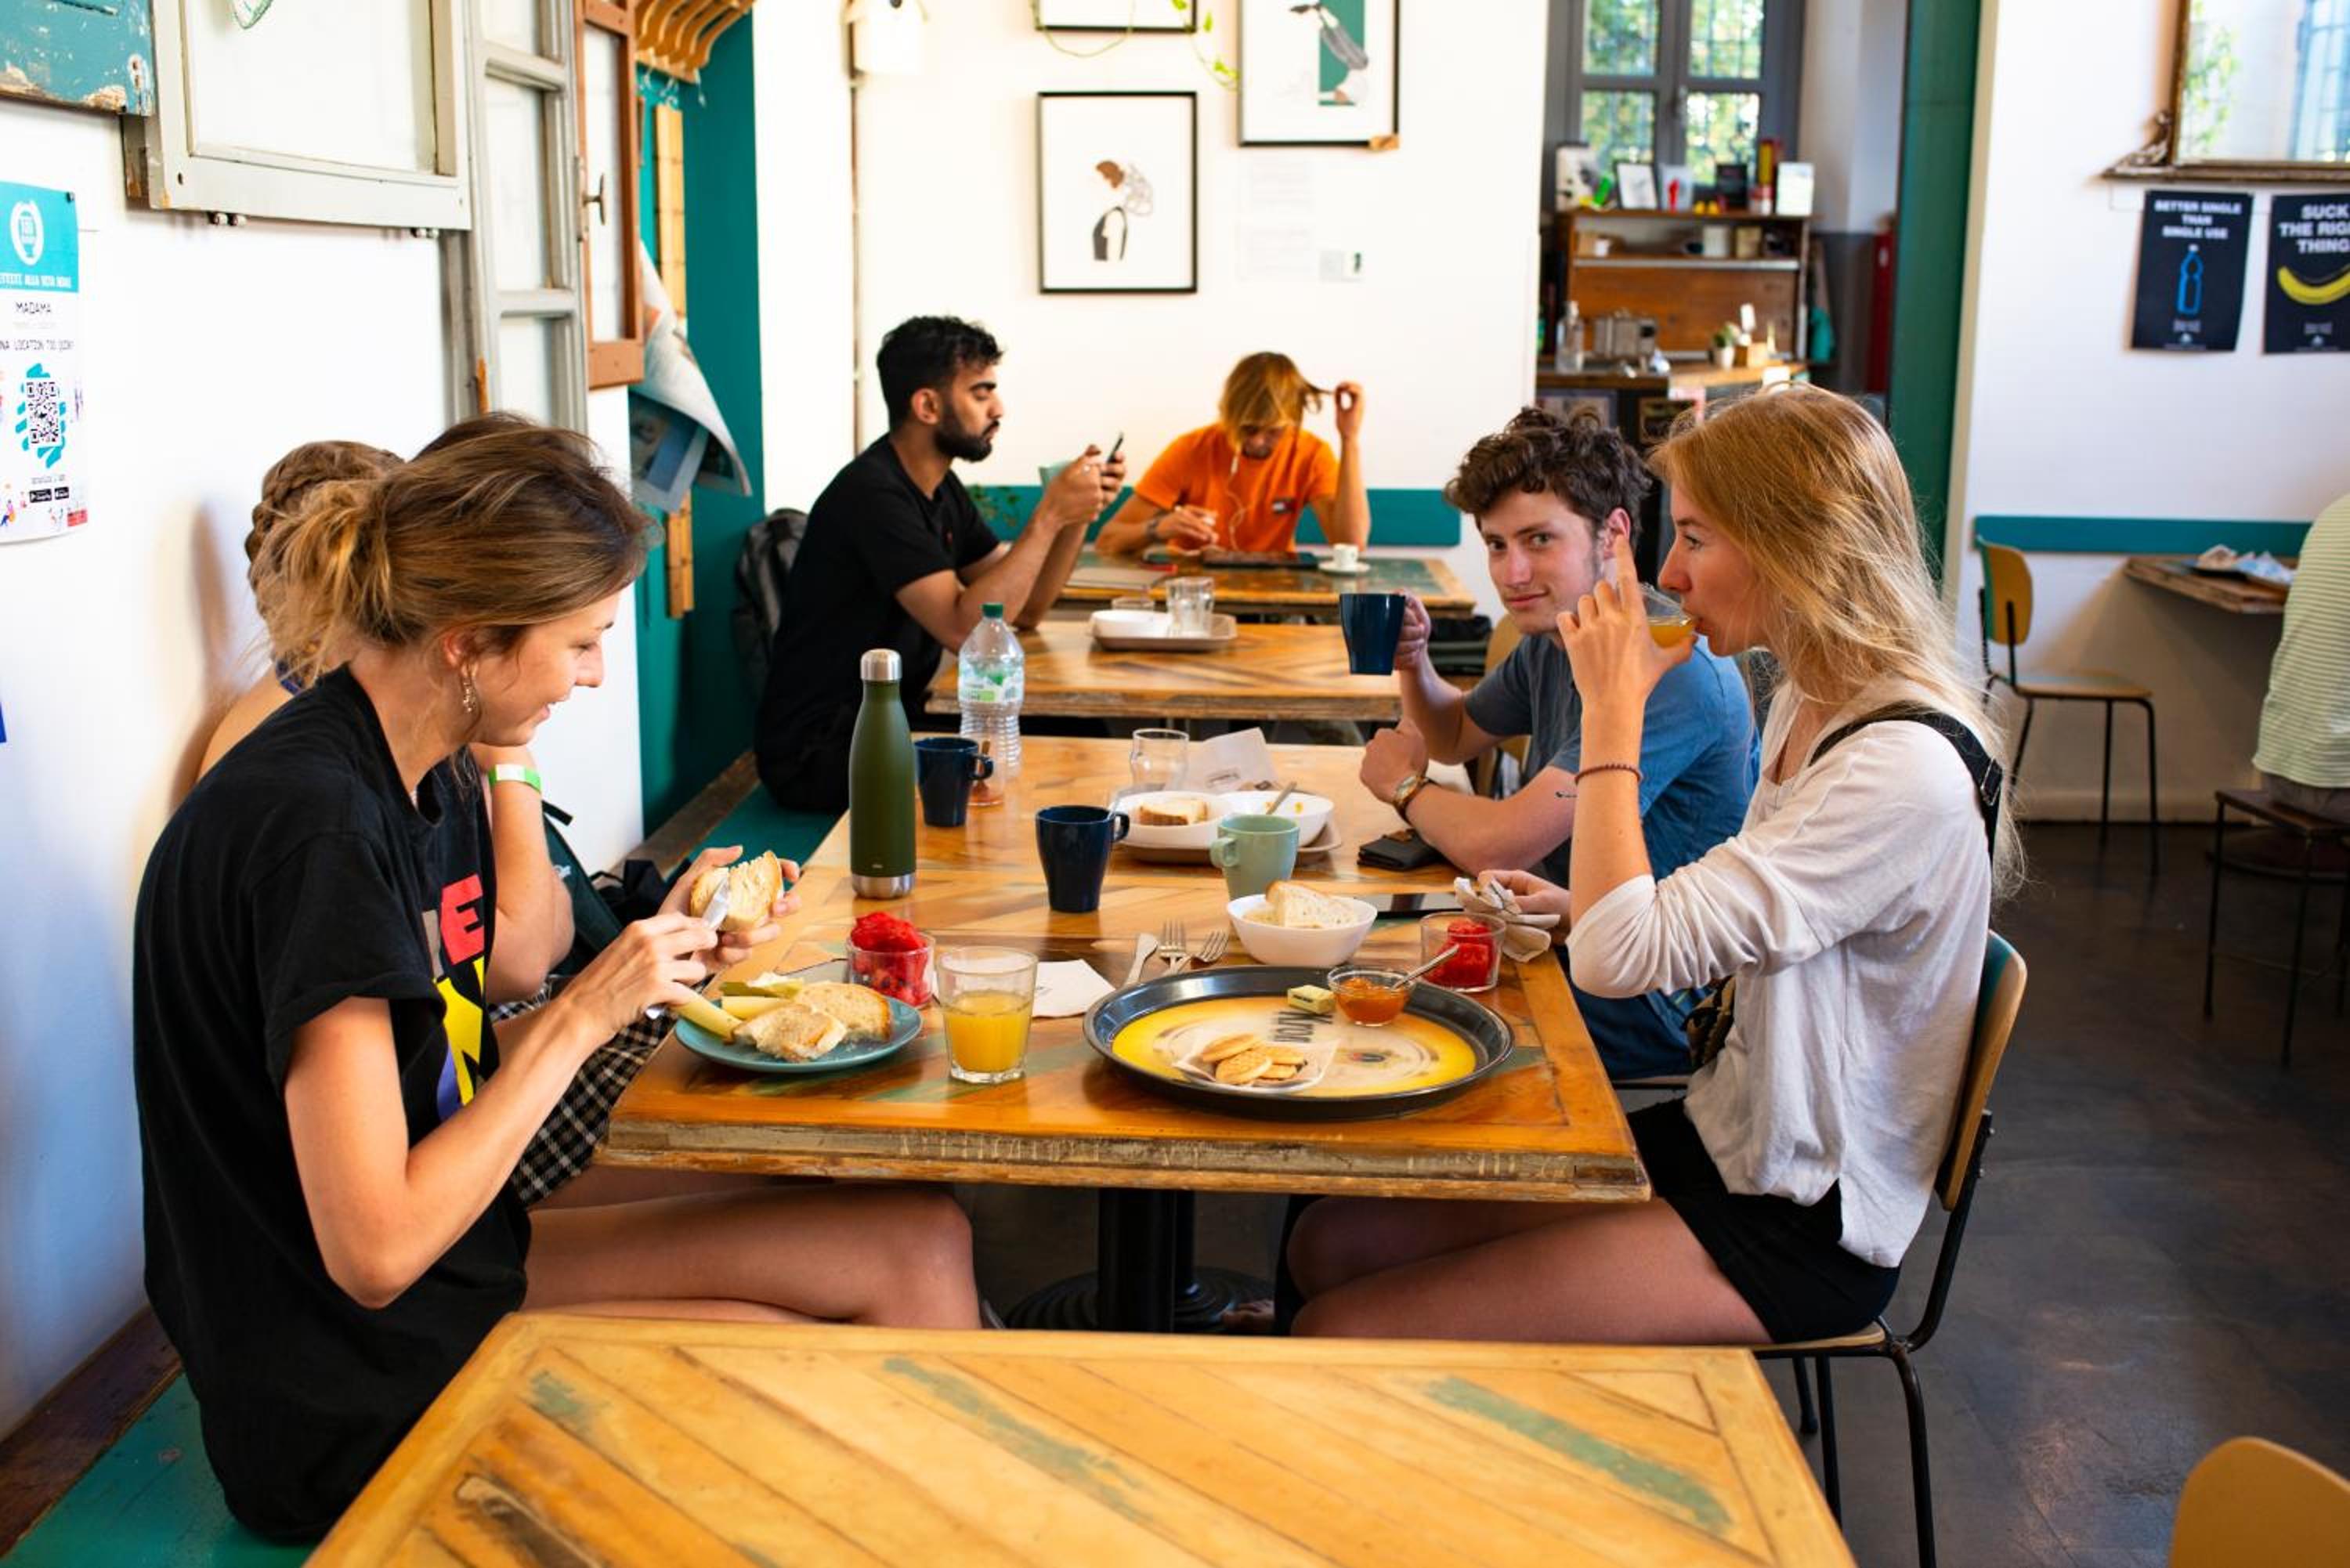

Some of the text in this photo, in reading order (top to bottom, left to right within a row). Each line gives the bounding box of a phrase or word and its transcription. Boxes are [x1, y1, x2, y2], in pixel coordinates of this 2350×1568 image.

[2154, 200, 2242, 215] BETTER SINGLE
[2301, 204, 2349, 221] SUCK
[2181, 213, 2213, 226] THAN
[2163, 226, 2229, 240] SINGLE USE
[2277, 221, 2313, 238] THE
[15, 301, 52, 315] MADAMA
